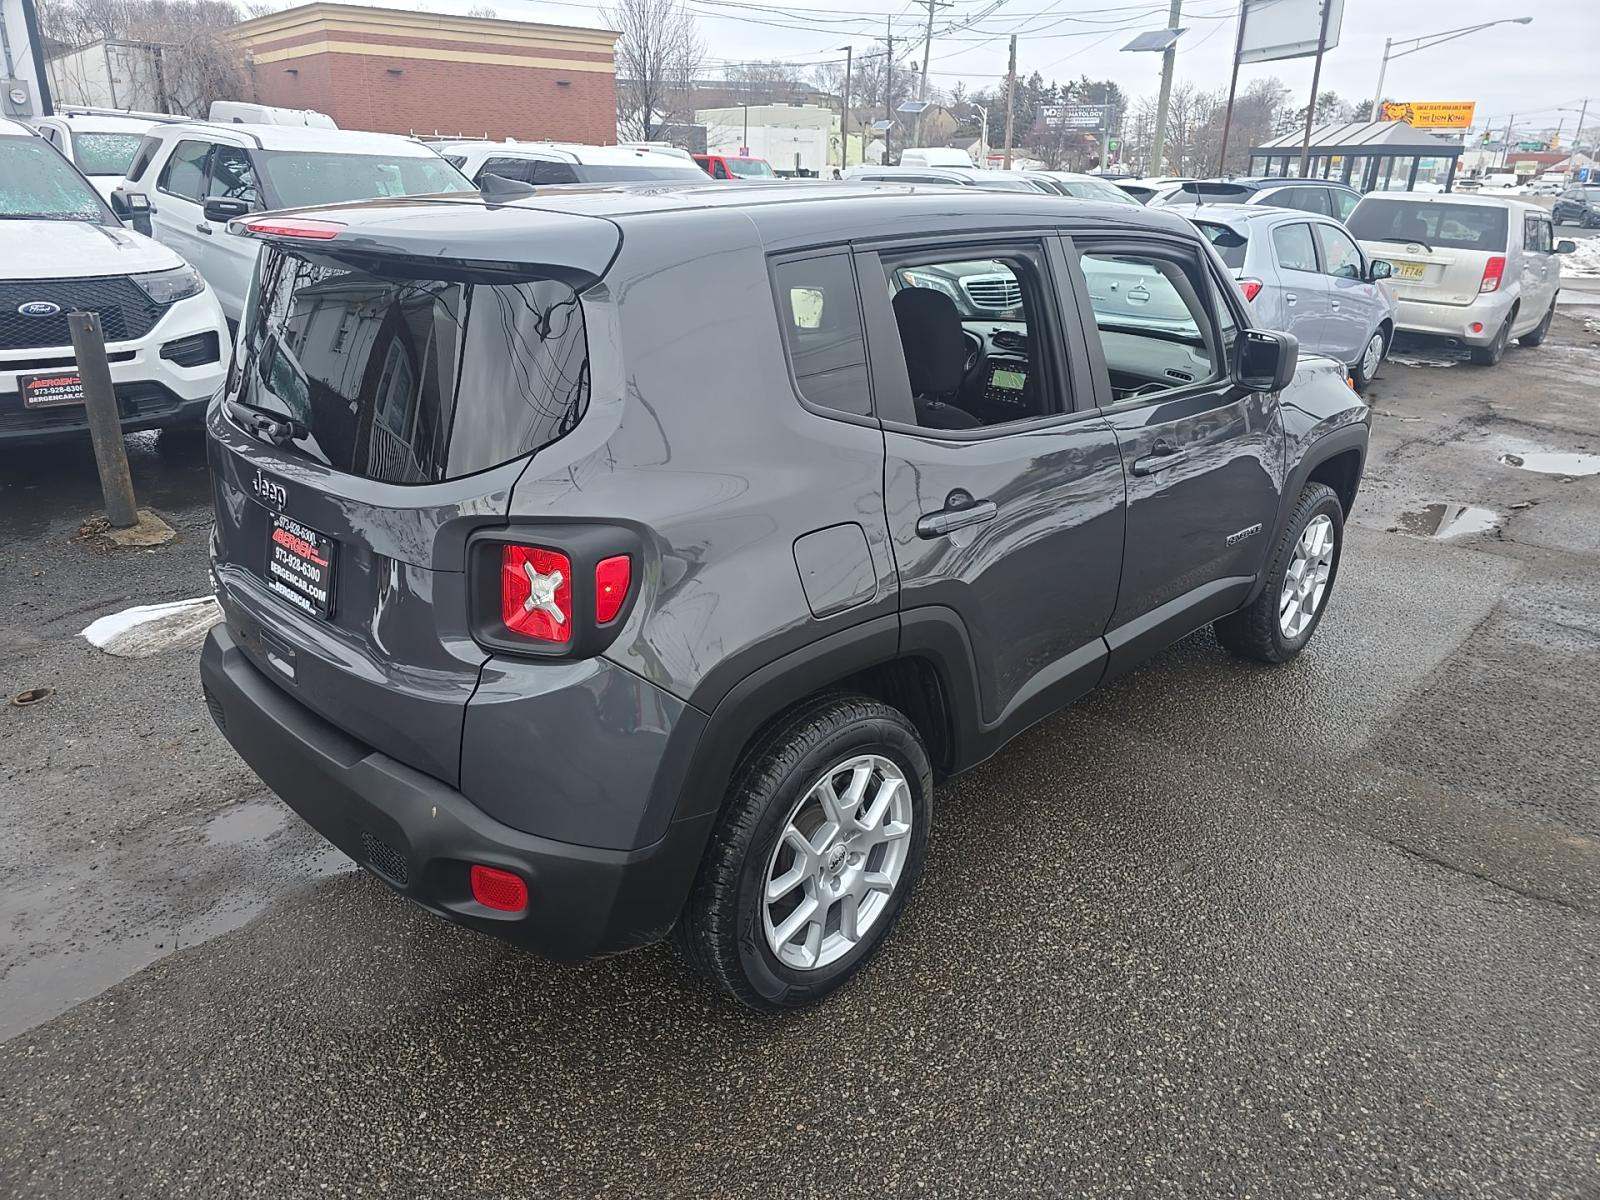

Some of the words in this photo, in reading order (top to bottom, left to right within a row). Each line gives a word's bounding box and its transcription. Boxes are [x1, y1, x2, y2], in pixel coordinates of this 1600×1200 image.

[29, 304, 51, 313] Ford
[28, 392, 85, 403] BERGENCAR.CO
[252, 468, 287, 511] Jeep
[270, 560, 327, 602] BERGENCAR.COM
[275, 546, 321, 583] 973-928-6300
